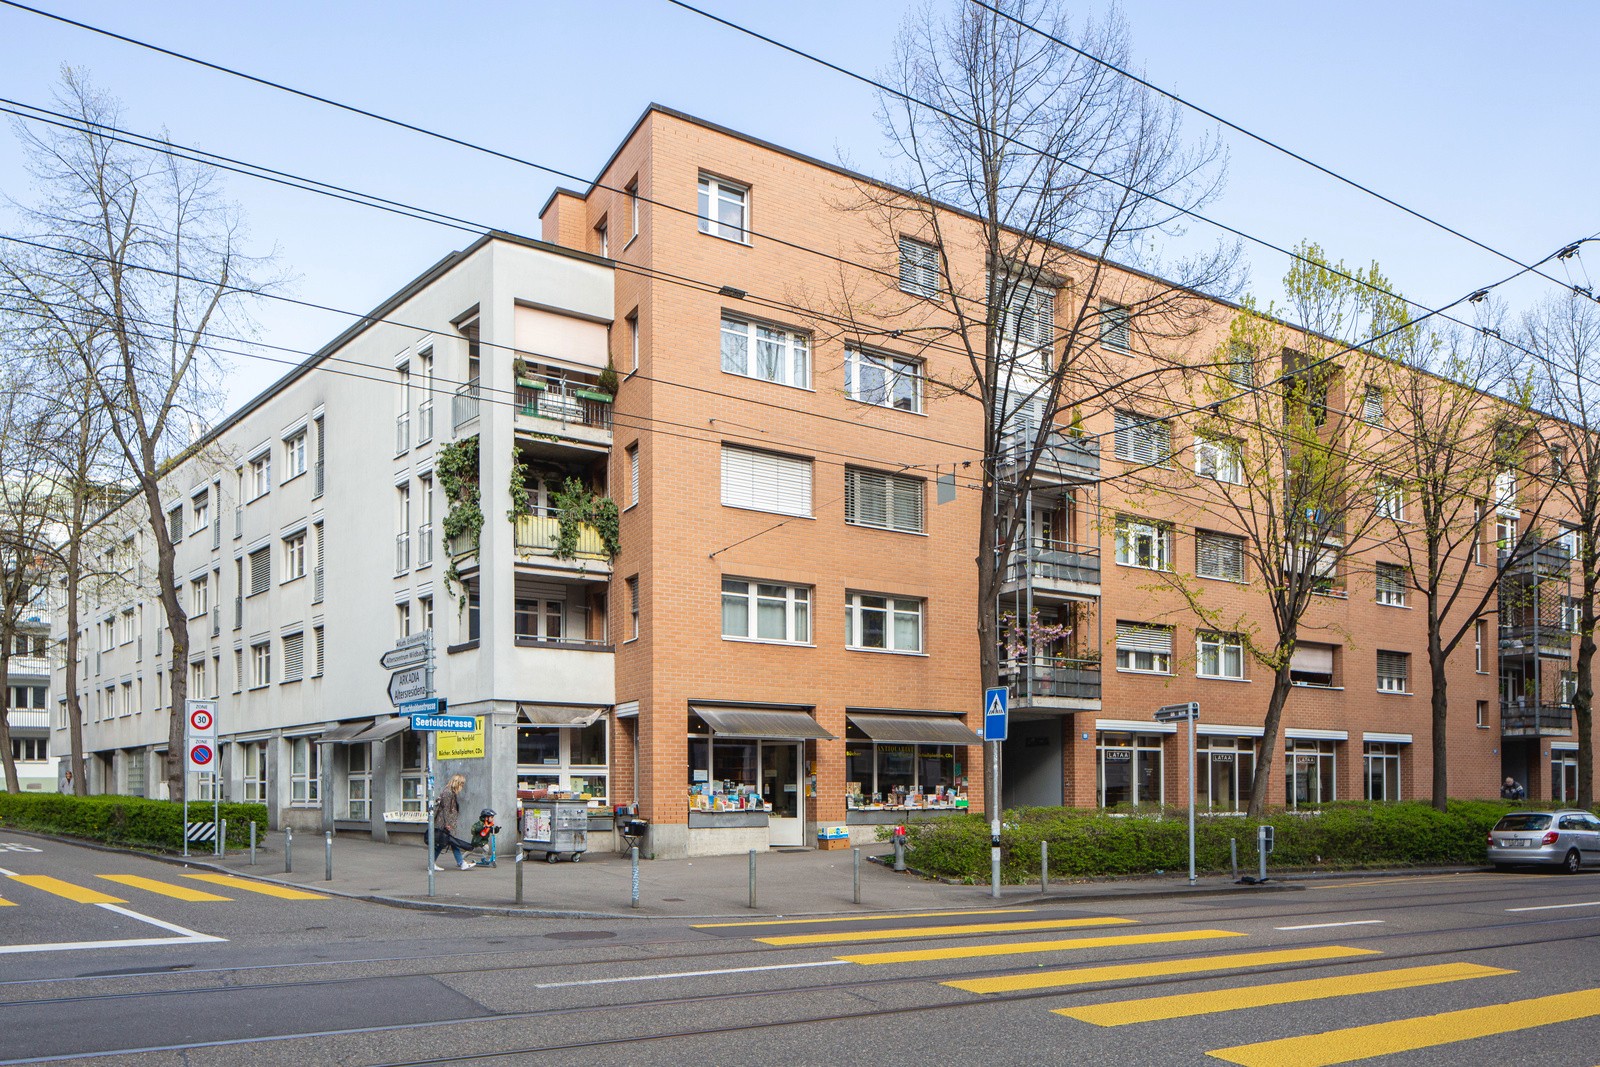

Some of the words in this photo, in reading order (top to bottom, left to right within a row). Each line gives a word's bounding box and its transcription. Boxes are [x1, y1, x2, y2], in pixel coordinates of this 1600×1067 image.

[394, 686, 426, 700] Altersresidenz
[197, 716, 207, 724] 30
[415, 717, 473, 728] Seefeldstrasse
